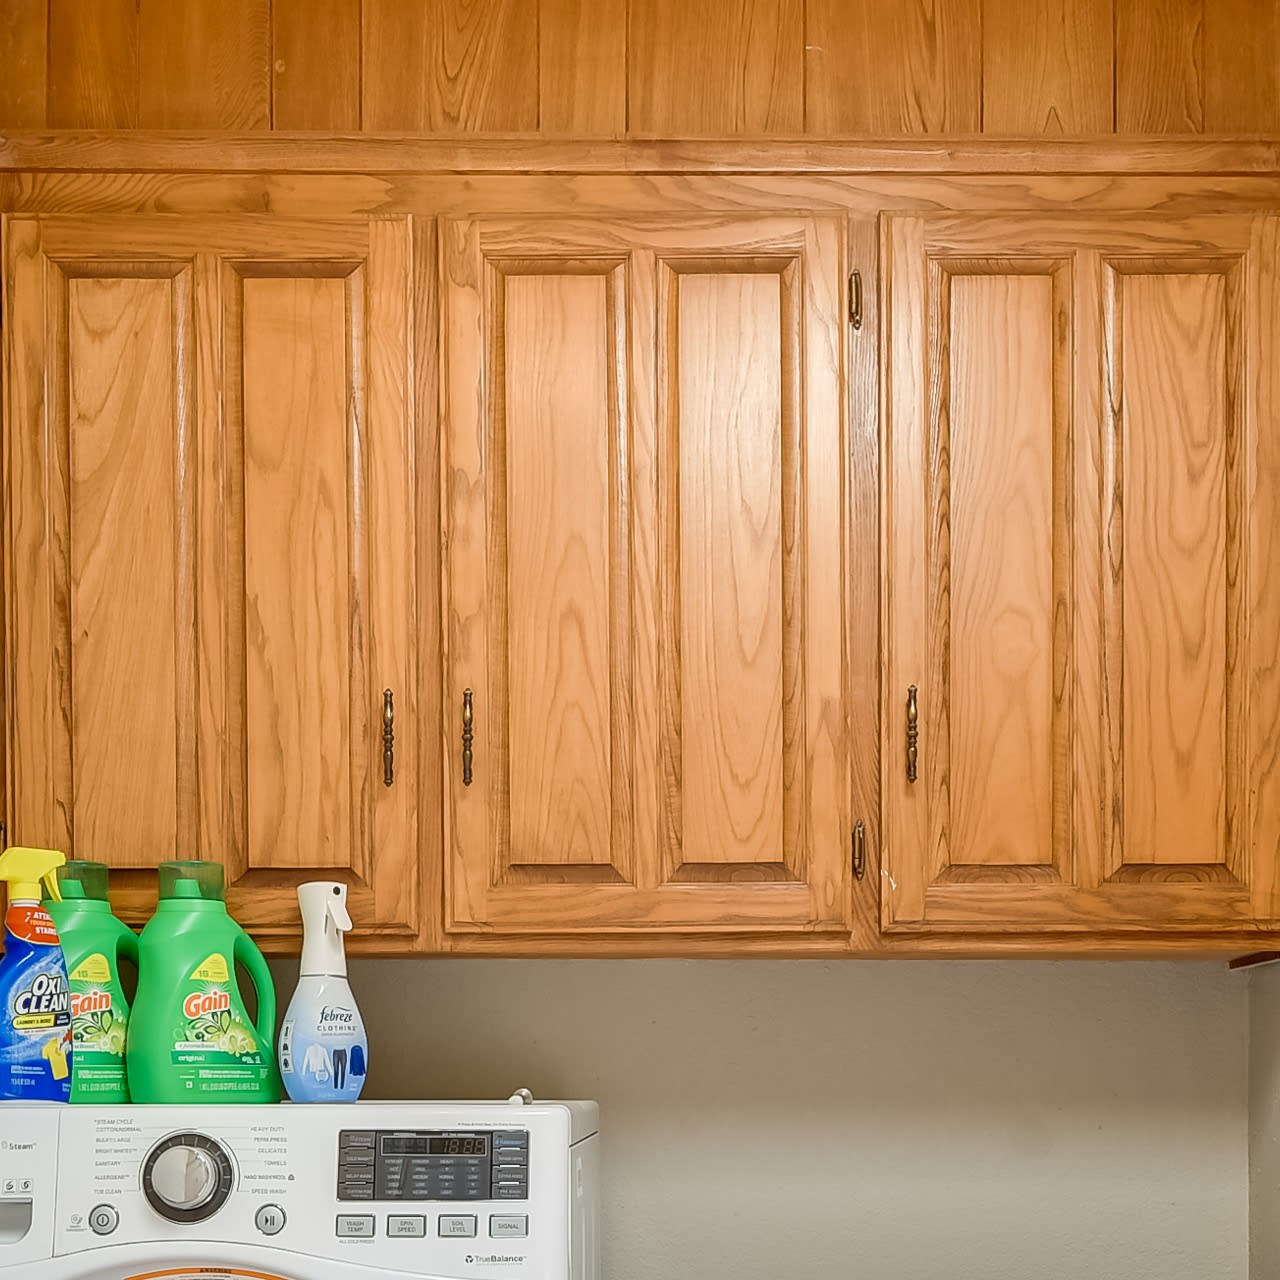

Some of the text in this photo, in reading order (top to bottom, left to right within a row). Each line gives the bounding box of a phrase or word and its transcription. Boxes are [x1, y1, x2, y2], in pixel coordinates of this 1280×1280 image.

[31, 974, 62, 996] OXI
[14, 990, 69, 1015] CLEAN
[184, 991, 229, 1018] Gain
[320, 1006, 353, 1023] febreze
